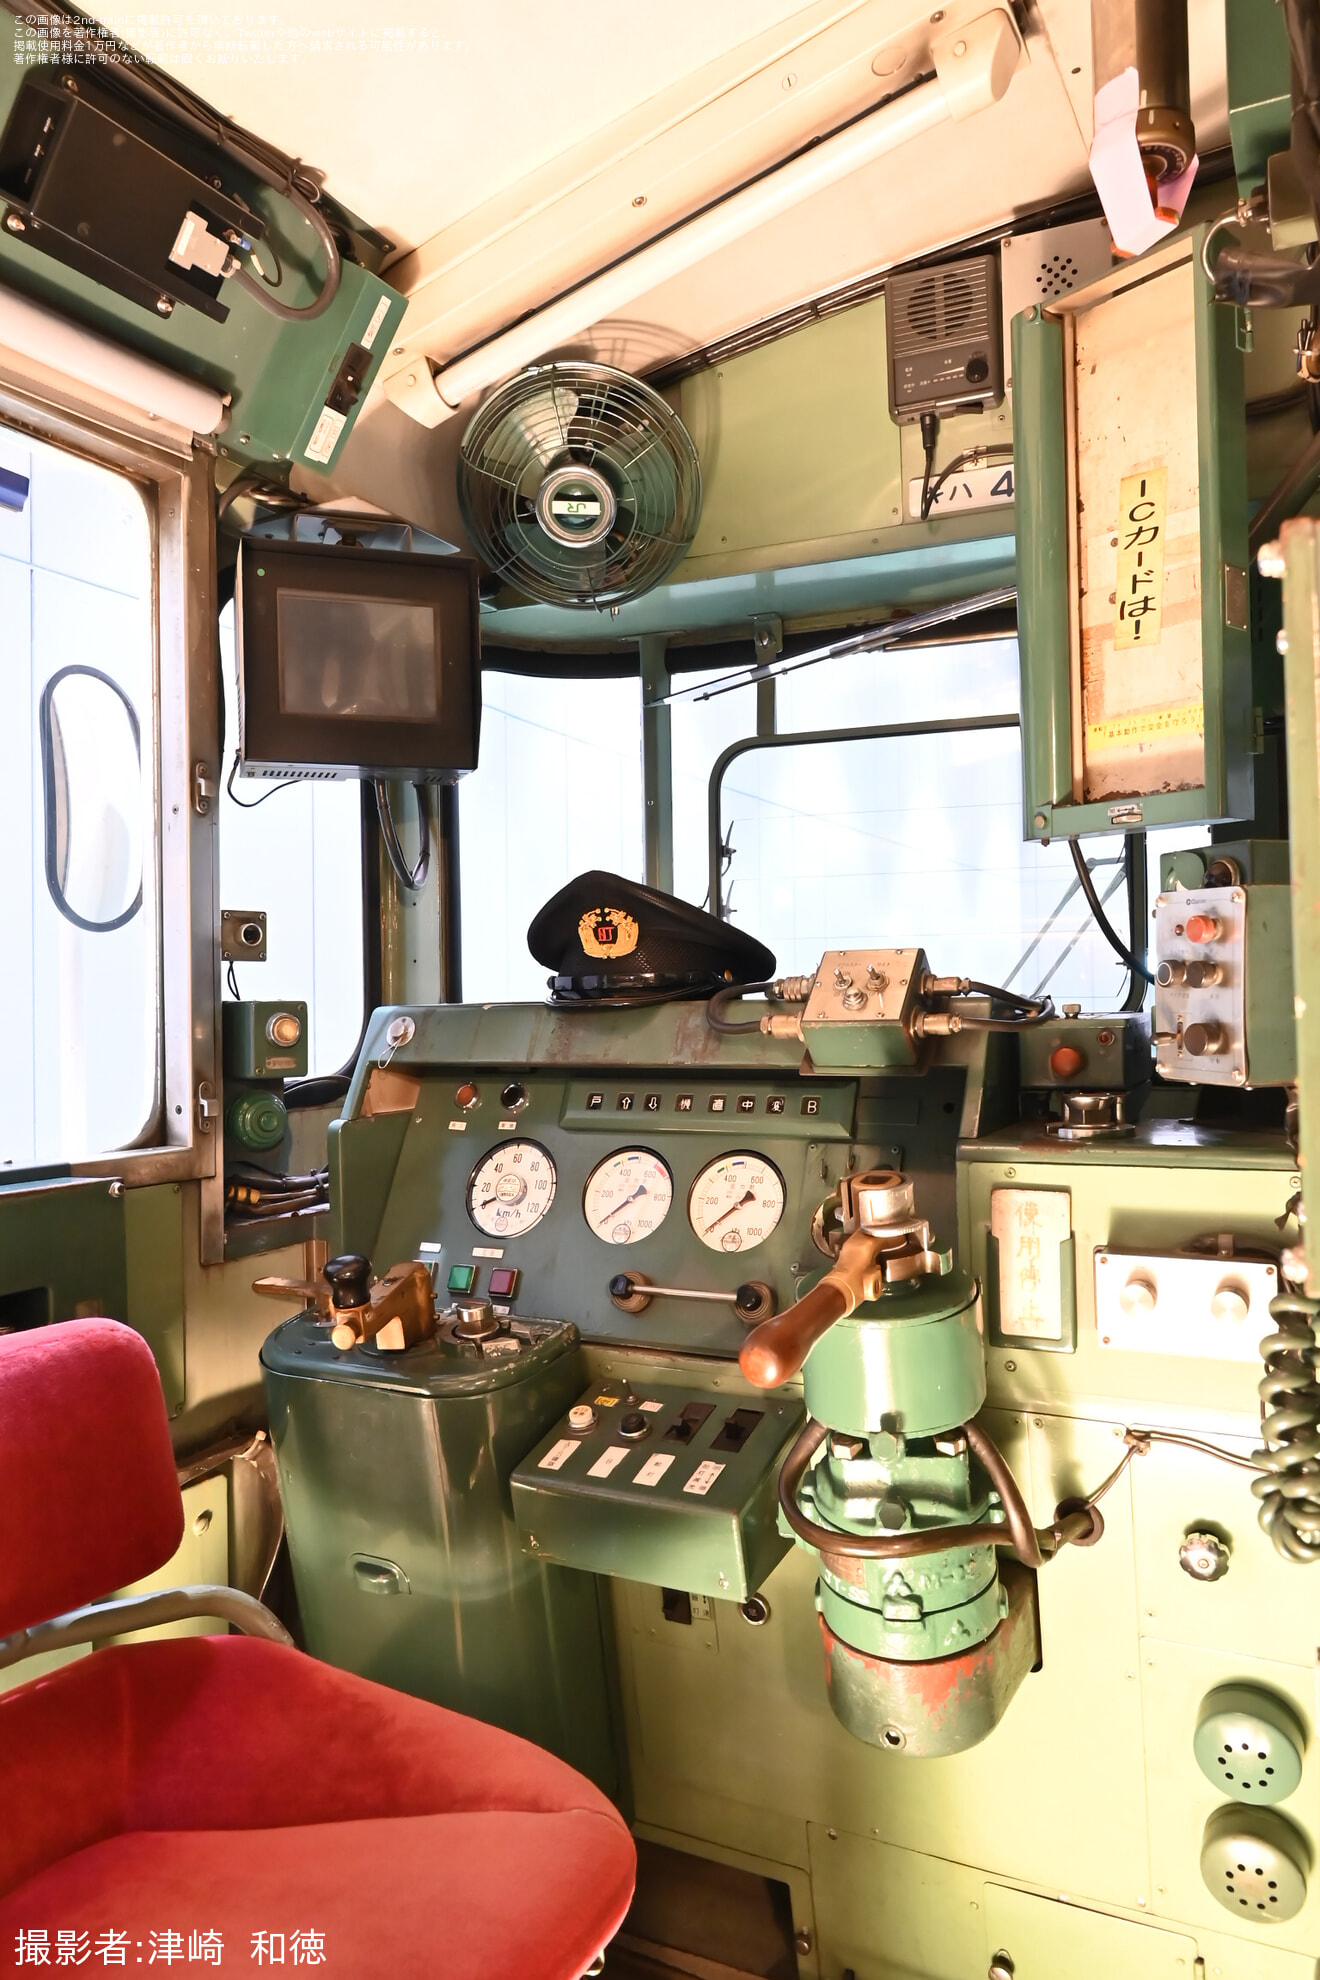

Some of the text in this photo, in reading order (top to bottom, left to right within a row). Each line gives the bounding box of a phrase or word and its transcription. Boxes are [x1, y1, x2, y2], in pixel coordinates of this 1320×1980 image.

[990, 470, 1014, 498] 4
[590, 1096, 602, 1107] 戸
[712, 1099, 724, 1111] 直
[741, 1100, 753, 1111] 中
[807, 1100, 817, 1113] B
[512, 1153, 522, 1164] 60
[494, 1163, 504, 1173] 40
[530, 1161, 540, 1172] 80
[619, 1169, 632, 1177] 400
[643, 1170, 656, 1178] 600
[724, 1174, 737, 1183] 400
[750, 1175, 764, 1184] 600
[481, 1182, 491, 1193] 20
[534, 1179, 548, 1191] 100
[601, 1189, 614, 1198] 200
[653, 1193, 666, 1202] 800
[705, 1196, 719, 1205] 200
[762, 1199, 776, 1208] 800
[526, 1202, 540, 1214] 120
[496, 1208, 521, 1218] km/h
[637, 1219, 653, 1228] 1000
[746, 1227, 763, 1236] 1000
